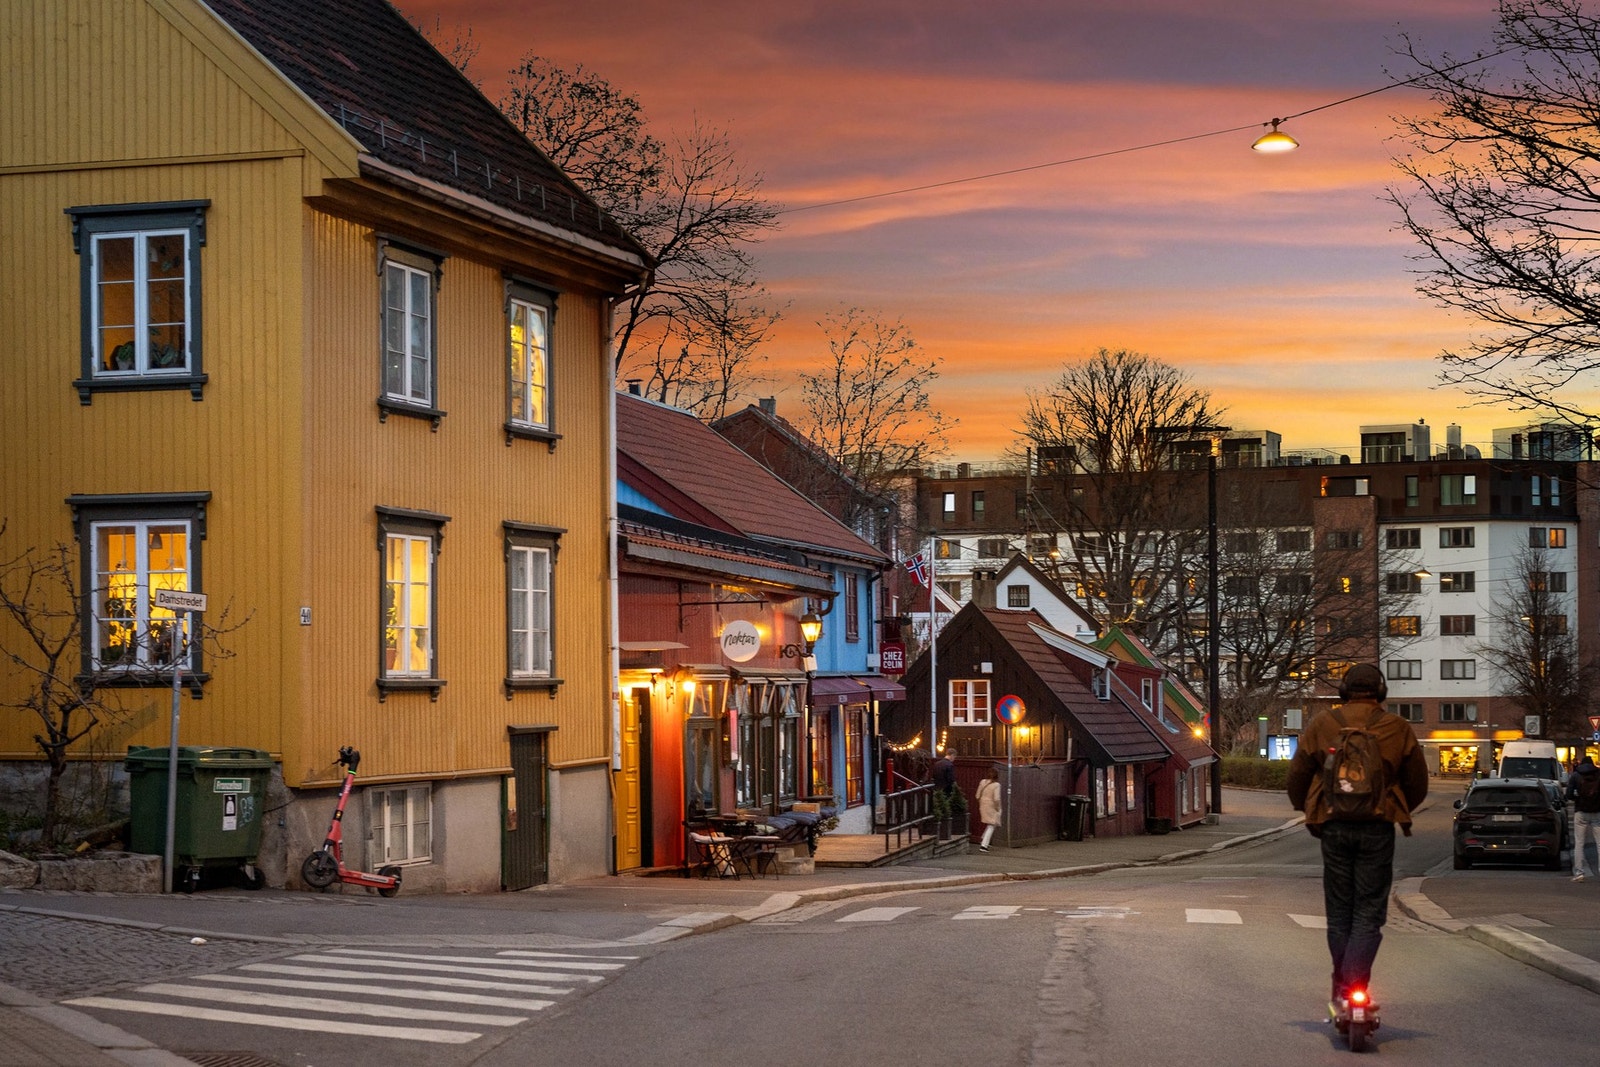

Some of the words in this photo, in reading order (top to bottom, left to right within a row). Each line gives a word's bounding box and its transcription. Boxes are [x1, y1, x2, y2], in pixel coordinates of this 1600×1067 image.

[159, 593, 202, 607] Damstredet
[883, 651, 903, 660] CHEZ
[883, 660, 903, 669] COLIN
